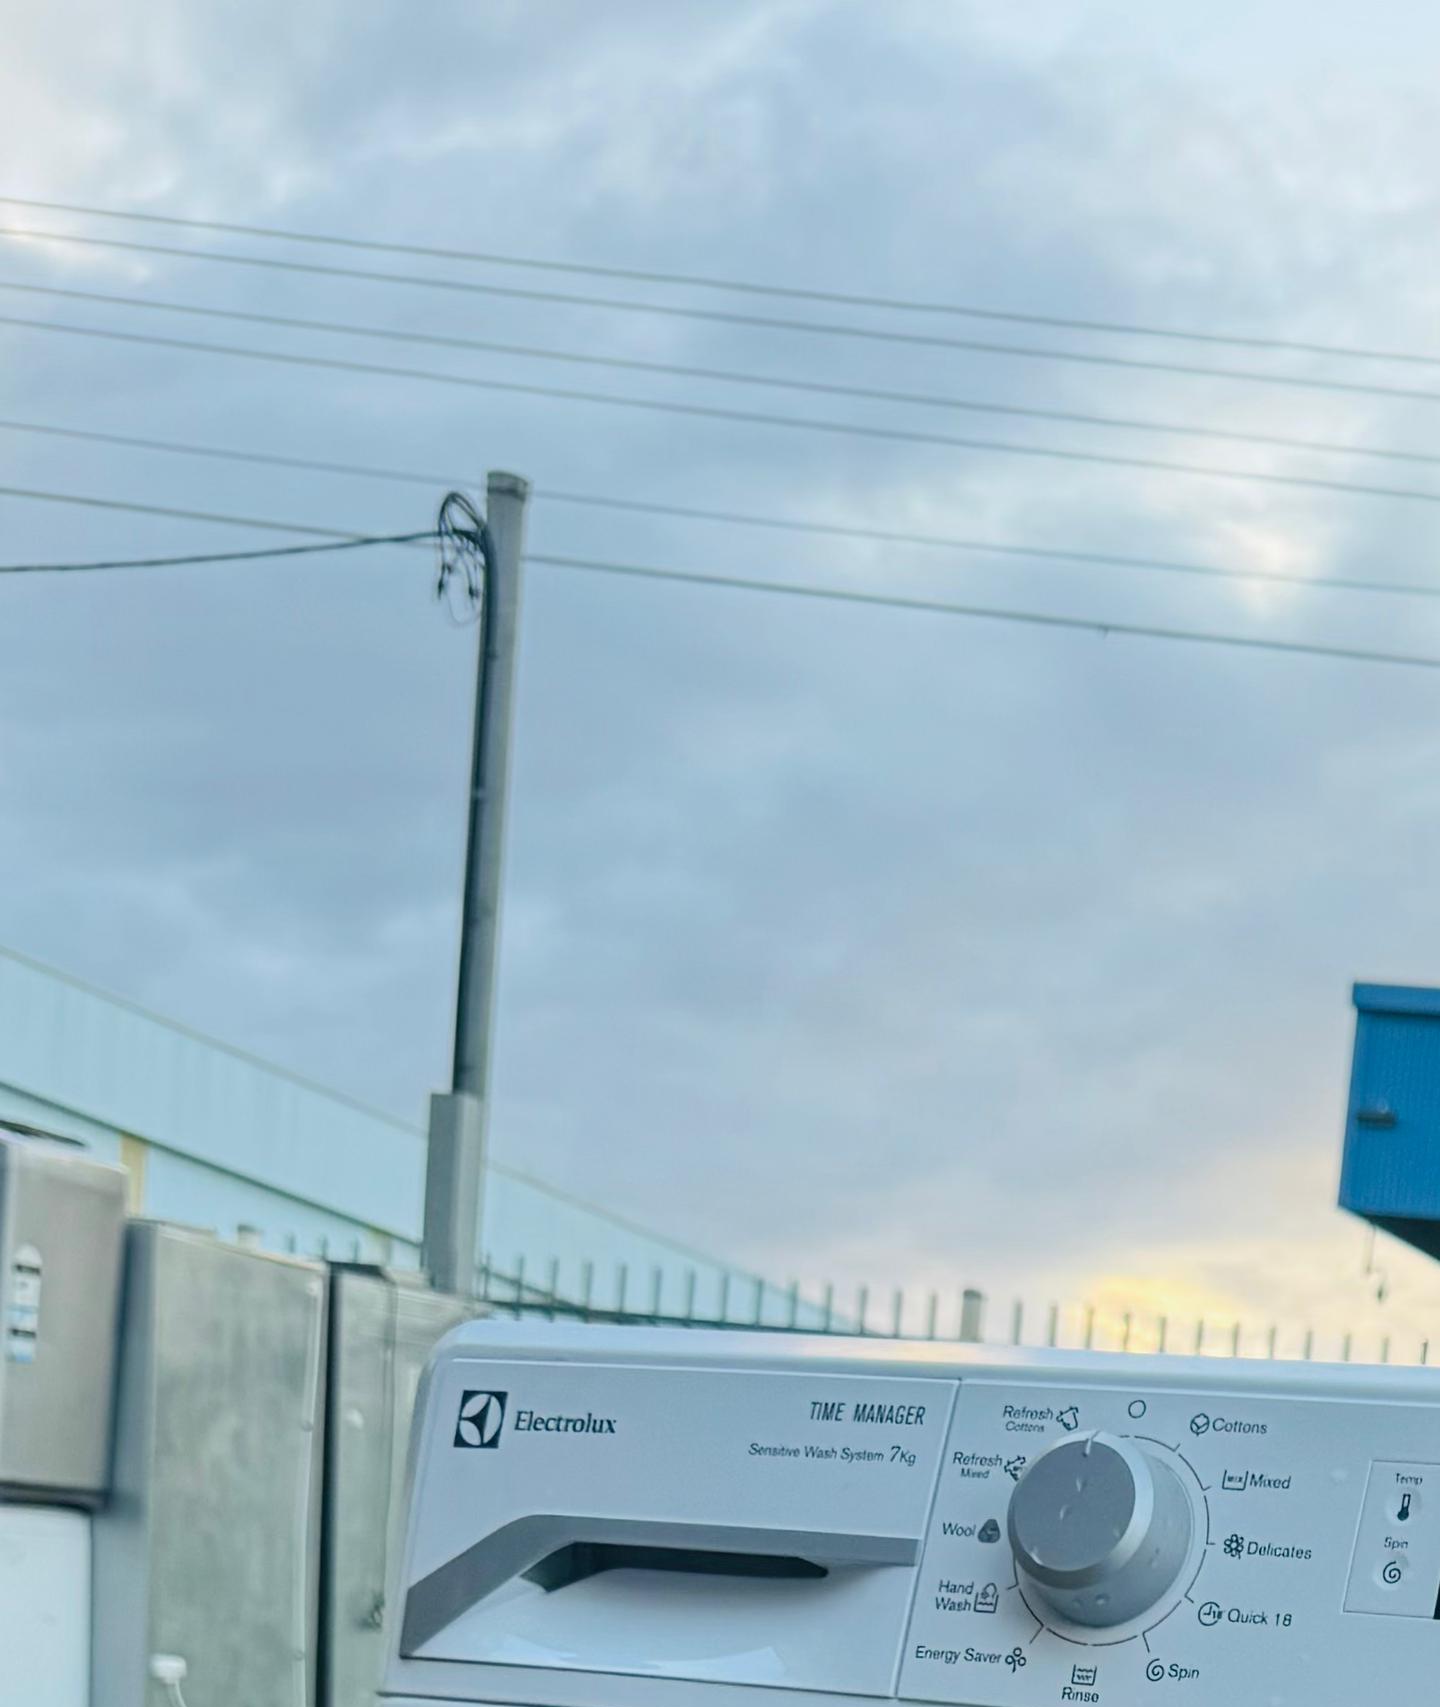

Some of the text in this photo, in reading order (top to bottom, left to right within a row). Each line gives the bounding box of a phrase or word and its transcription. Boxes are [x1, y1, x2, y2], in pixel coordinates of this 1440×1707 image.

[810, 1401, 926, 1426] TIME MANAGER
[1002, 1405, 1053, 1421] Refresh
[514, 1410, 617, 1434] Electrolux
[1005, 1421, 1045, 1433] Cottons
[1212, 1417, 1268, 1435] Cottons
[748, 1443, 801, 1458] Sensitive
[804, 1446, 838, 1460] Wash
[840, 1447, 885, 1464] System
[953, 1451, 1003, 1467] Refresh
[1250, 1473, 1292, 1489] Mixed
[942, 1522, 976, 1537] Wool
[1247, 1541, 1312, 1560] Delicates
[938, 1579, 974, 1596] Hand
[935, 1597, 972, 1612] Wash
[1227, 1608, 1268, 1625] Quick
[1275, 1613, 1292, 1627] 18
[915, 1645, 1002, 1664] Energy Saver
[1167, 1663, 1200, 1681] Spin
[1061, 1686, 1100, 1703] Rinse
